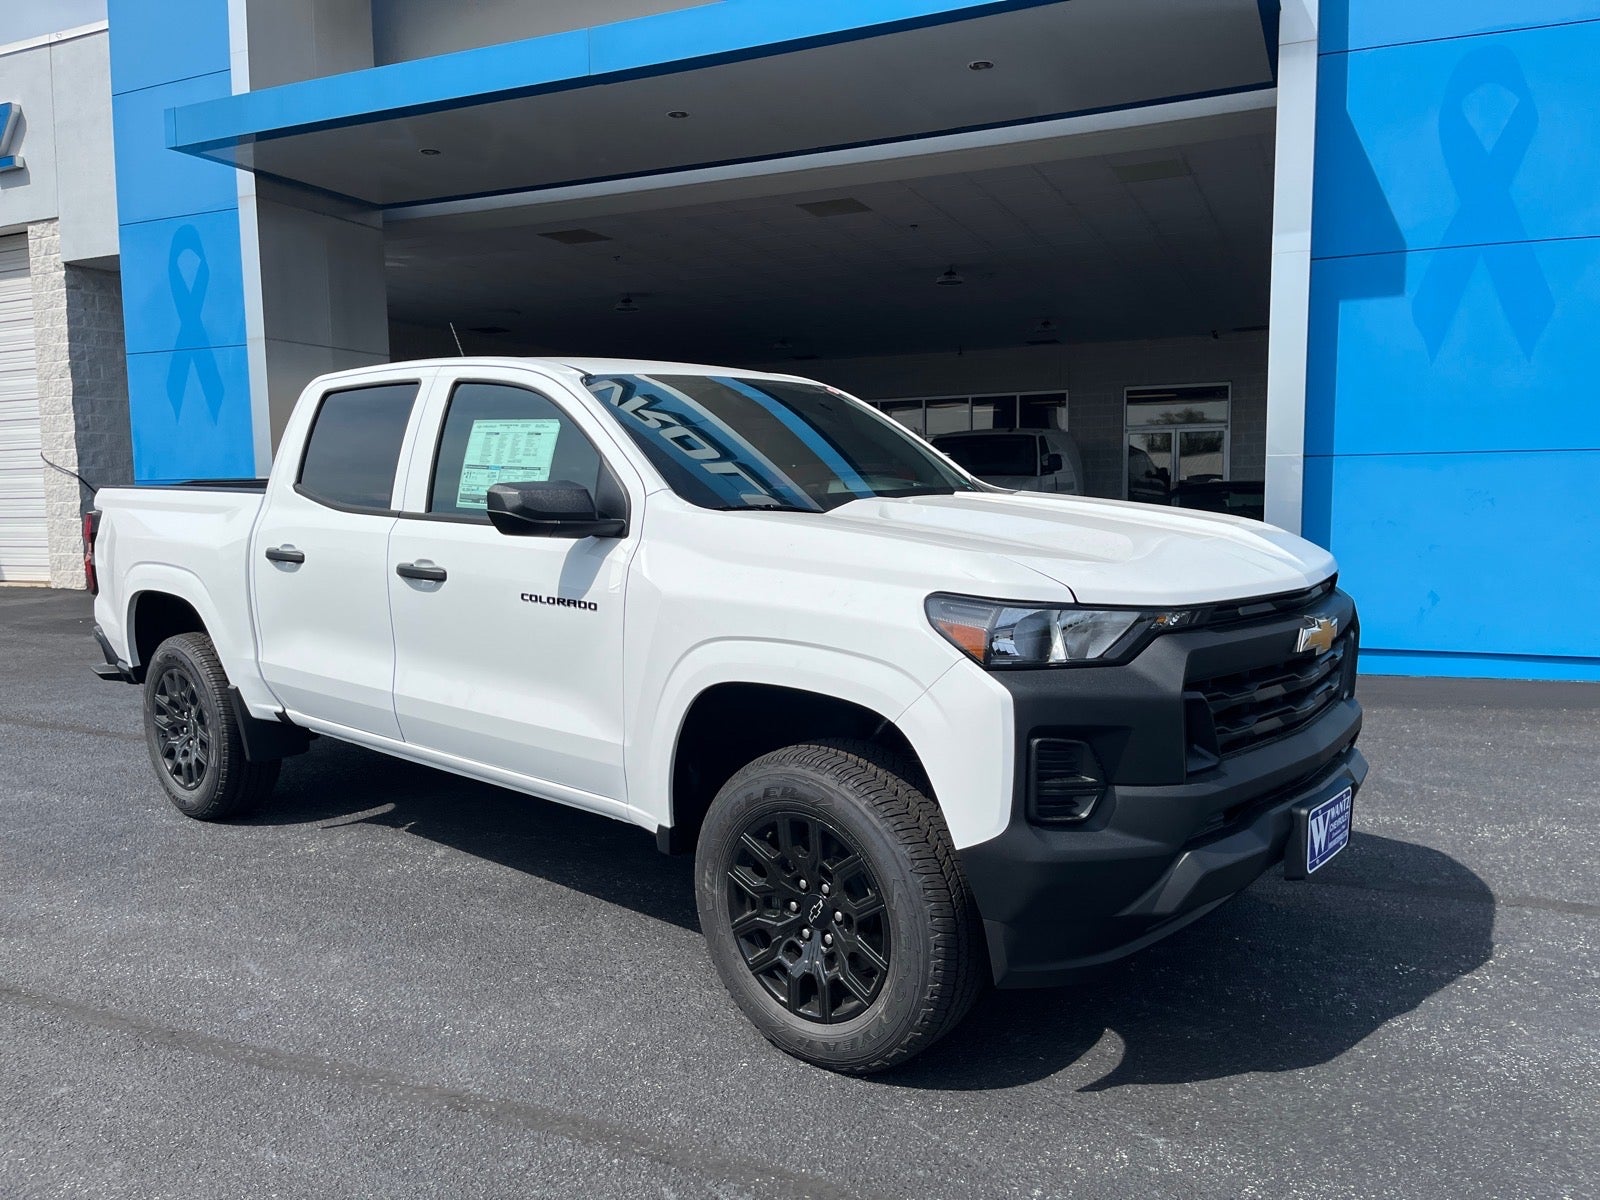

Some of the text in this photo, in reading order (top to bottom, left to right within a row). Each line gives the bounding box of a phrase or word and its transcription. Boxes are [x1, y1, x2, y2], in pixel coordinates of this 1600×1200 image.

[521, 593, 597, 611] COLORADO
[1330, 796, 1350, 820] WANTZ
[1311, 810, 1331, 857] W
